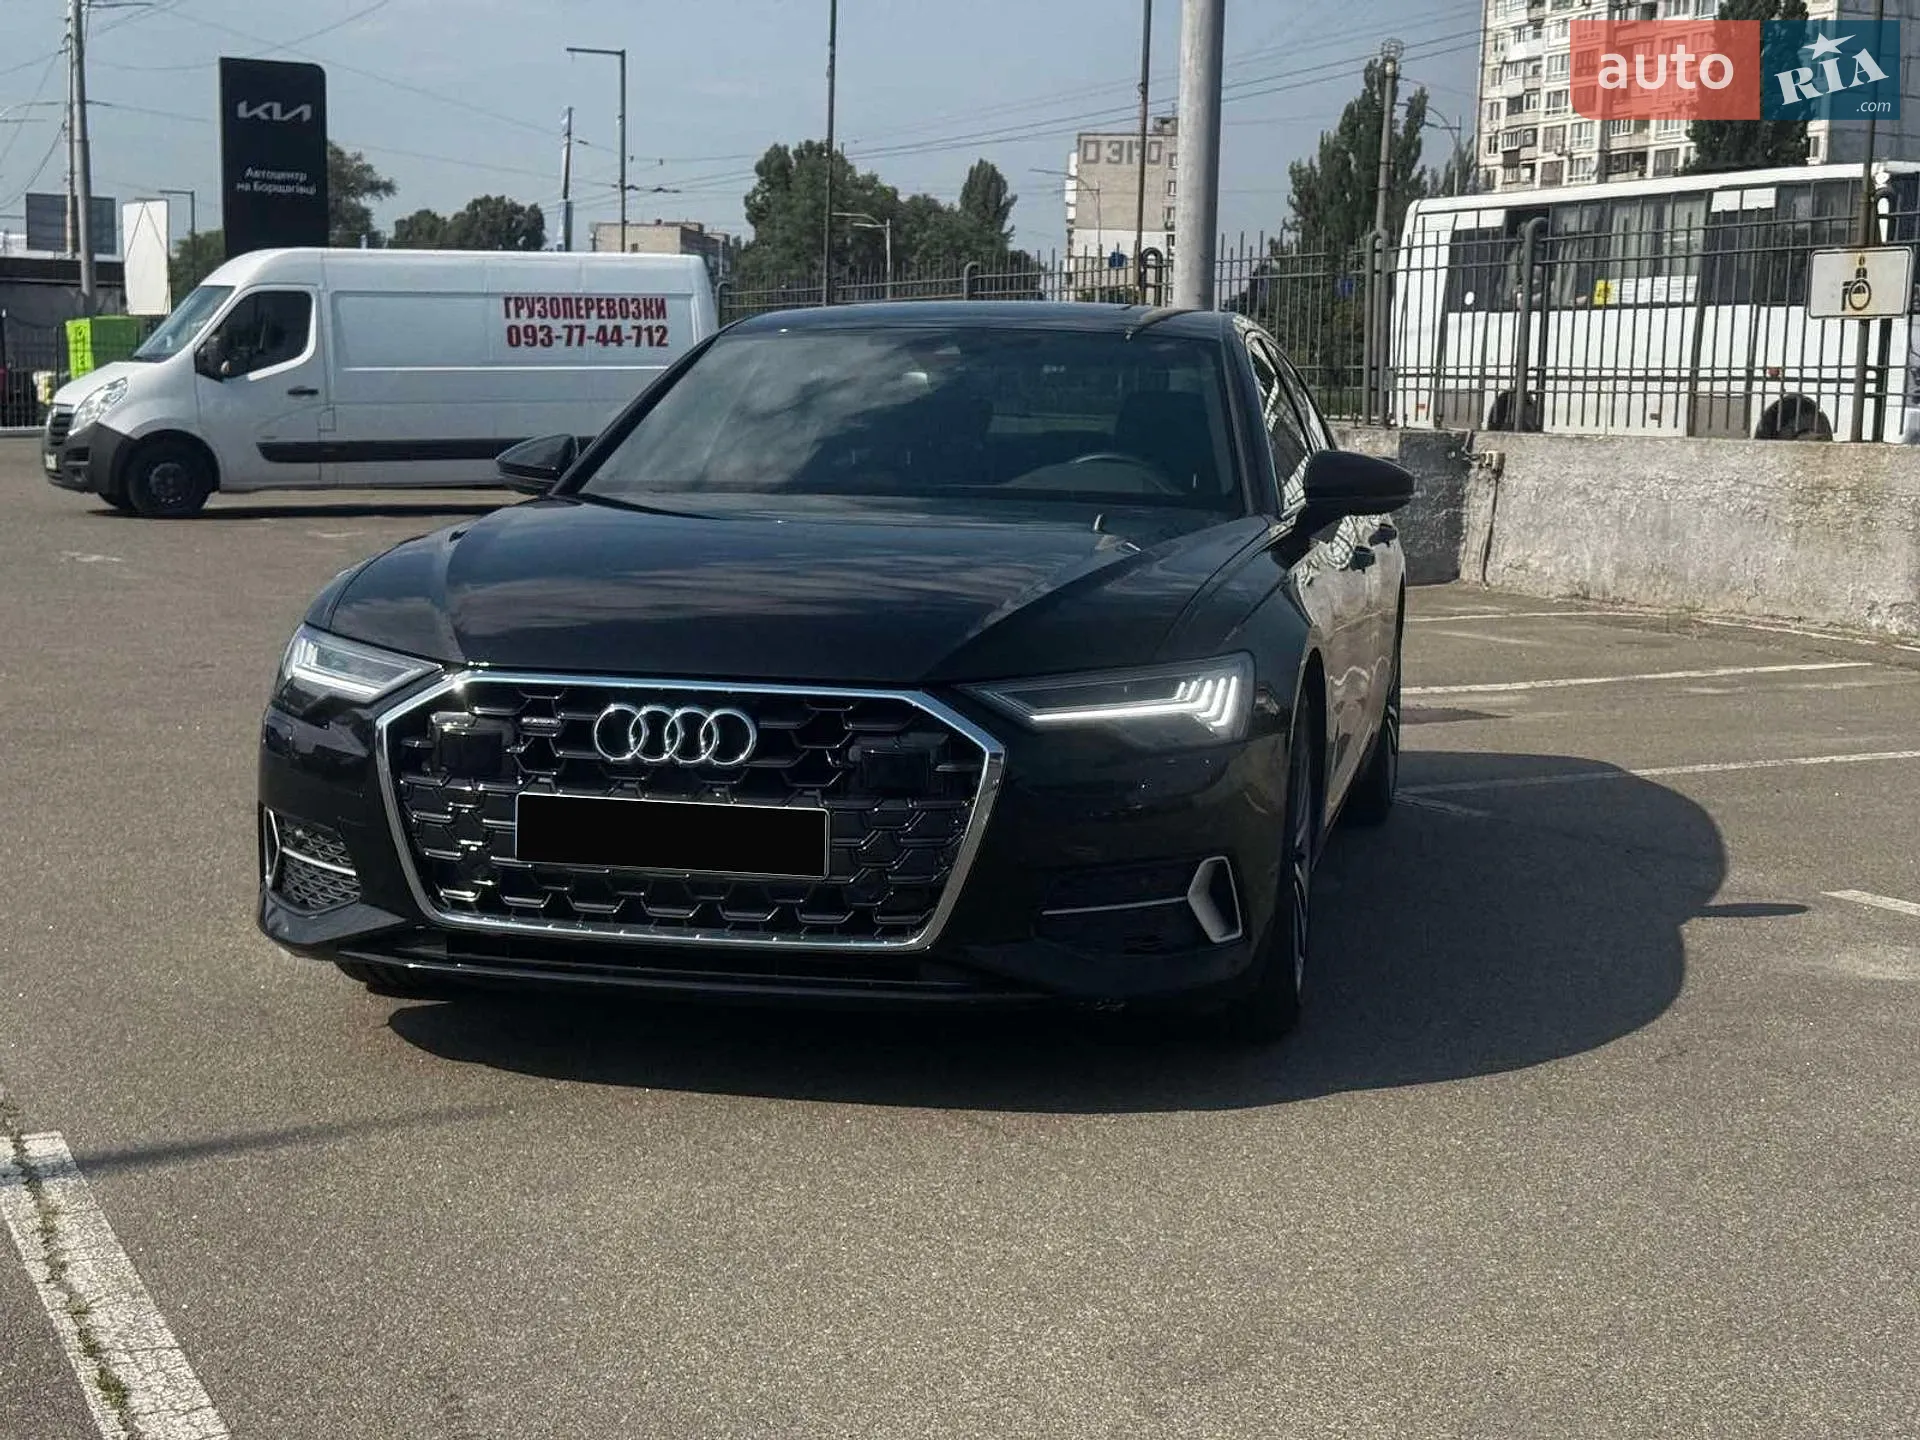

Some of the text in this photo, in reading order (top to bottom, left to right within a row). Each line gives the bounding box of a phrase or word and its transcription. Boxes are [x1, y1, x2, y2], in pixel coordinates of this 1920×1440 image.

[237, 100, 312, 121] KIA
[245, 167, 307, 182] Автоцентр
[237, 183, 251, 192] на
[503, 296, 667, 319] ГРУЗОПЕРЕВОЗКИ
[507, 324, 669, 348] 093-77-44-712
